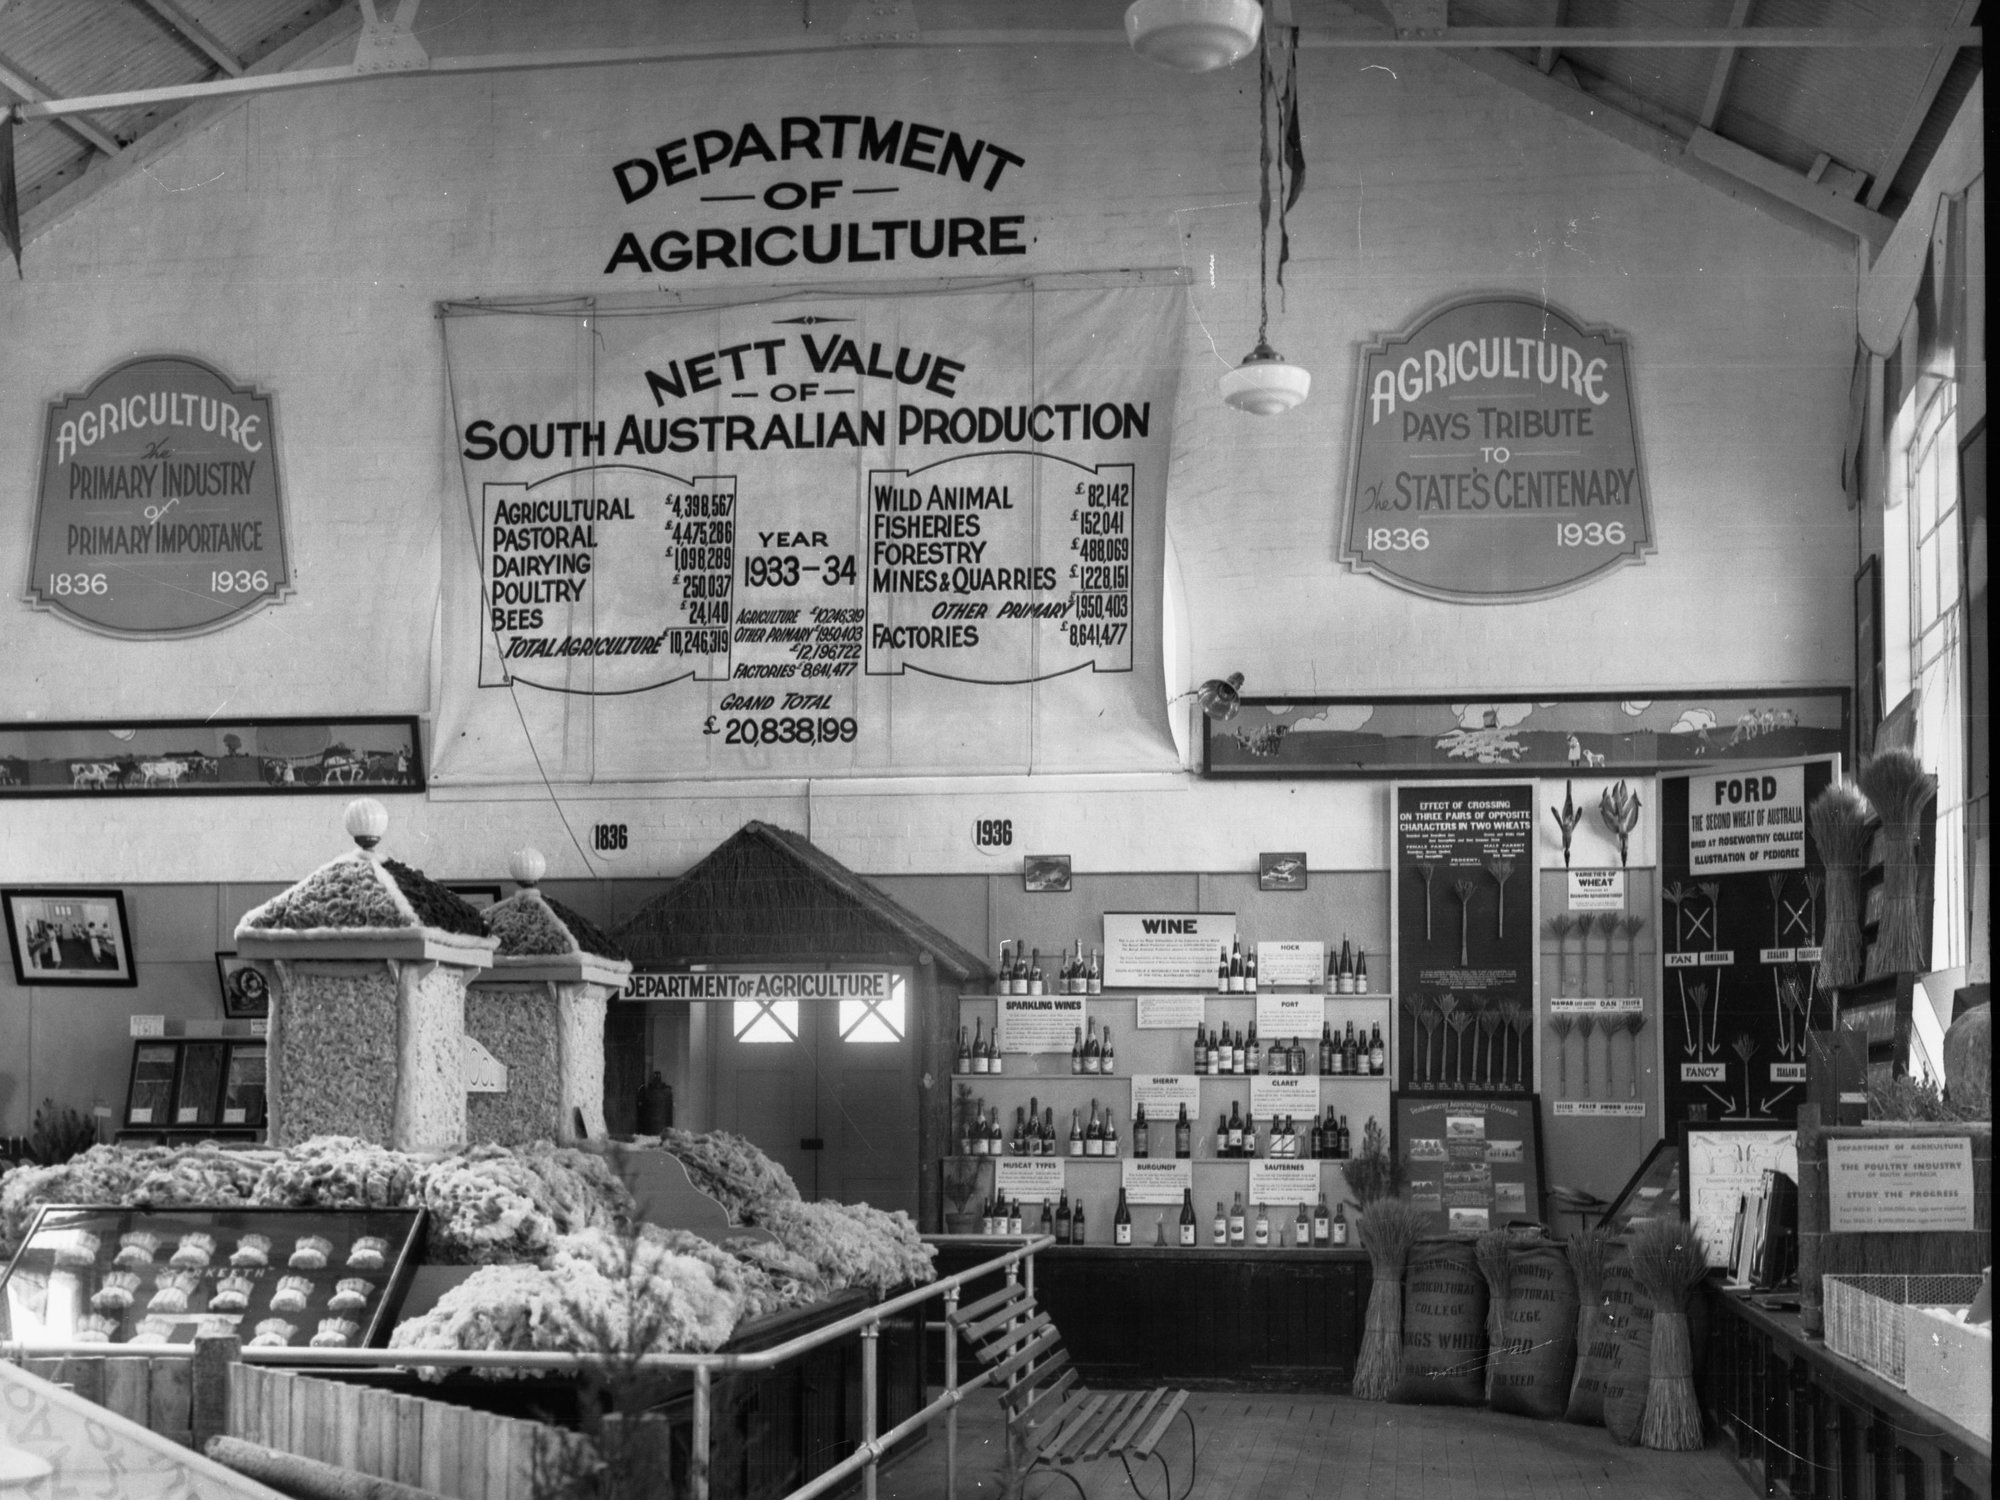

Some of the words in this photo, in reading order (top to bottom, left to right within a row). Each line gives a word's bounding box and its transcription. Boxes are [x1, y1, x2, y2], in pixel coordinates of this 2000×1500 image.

[612, 115, 1025, 204] DEPARTMENT
[763, 180, 843, 211] OF
[604, 215, 1027, 274] AGRICULTURE
[644, 338, 786, 408] NETT
[800, 333, 966, 398] VALUE
[1371, 336, 1610, 426] AGRICULTURE
[769, 383, 819, 403] OF
[56, 391, 262, 465] AGRICULTURE
[463, 419, 605, 461] SOUTH
[614, 408, 885, 457] AUSTRALIAN
[898, 401, 1150, 446] PRODUCTION
[1403, 411, 1471, 442] PAYS
[1477, 407, 1593, 439] TRIBUTE
[141, 437, 172, 460] The
[1480, 447, 1510, 463] TO
[70, 461, 158, 499] PRIMARY
[162, 460, 255, 497] INDUSTRY
[1361, 480, 1389, 513] The
[1393, 466, 1490, 511] STATE'S
[1494, 468, 1635, 509] CENTENARY
[494, 498, 635, 525] AGRICULTURAL
[665, 494, 734, 519] £4,398,567
[874, 485, 922, 512] WILD
[927, 484, 1014, 510] ANIMAL
[1075, 482, 1129, 509] £82,142
[144, 498, 179, 524] of
[874, 514, 980, 538] FISHERIES
[1070, 509, 1124, 536] £152,041
[68, 524, 153, 555] PRIMARY
[156, 521, 263, 553] IMPORTANCE
[493, 525, 598, 552] PASTORAL
[665, 520, 732, 546] £4,475,286
[758, 531, 829, 548] YEAR
[1367, 527, 1429, 550] 1836
[1557, 522, 1626, 546] 1936
[493, 553, 591, 579] DAIRYING
[665, 546, 731, 572] £1,098,289
[874, 541, 987, 565] FORESTRY
[1071, 537, 1128, 564] £488,069
[50, 573, 108, 595] 1836
[211, 570, 269, 592] 1936
[744, 554, 857, 587] 1933-34
[492, 579, 586, 606] POULTRY
[672, 574, 731, 600] £250,037
[491, 608, 544, 632] BEES
[680, 600, 729, 626] £24,140
[735, 608, 801, 624] AGRICULTURE
[932, 601, 988, 620] OTHER
[996, 601, 1075, 619] PRIMARY
[1069, 592, 1127, 620] £1,950,403
[504, 636, 556, 659] TOTAL
[554, 635, 663, 658] AGRICULTURE
[663, 629, 729, 656] £10,246,319
[734, 626, 766, 643] OTHER
[766, 626, 814, 642] PRIMARY
[872, 623, 979, 649] FACTORIES
[1060, 620, 1128, 648] £8,641,477
[733, 663, 796, 679] FACTORIES
[795, 661, 858, 679] £8,641,477
[719, 694, 774, 711] GRAND
[780, 693, 833, 711] TOTAL
[1715, 776, 1777, 805] FORD
[1399, 813, 1412, 821] ON
[1415, 813, 1443, 821] THREE
[1445, 812, 1472, 820] PAIRS
[1474, 812, 1485, 820] OF
[1488, 811, 1530, 820] OPPOSITE
[1419, 802, 1450, 811] EFFECT
[1452, 802, 1463, 810] OF
[1467, 800, 1511, 809] CROSSING
[1399, 822, 1457, 832] CHARACTERS
[1458, 822, 1468, 831] IN
[1470, 822, 1491, 831] TWO
[1493, 821, 1531, 831] WHEATS
[1692, 814, 1704, 832] THE
[1706, 811, 1731, 831] SECOND
[1733, 810, 1755, 829] WHEAT
[1757, 809, 1765, 826] OF
[1767, 806, 1803, 824] AUSTRALIA
[594, 825, 627, 850] 1836
[976, 820, 1012, 846] 1936
[1691, 840, 1706, 849] BRED
[1708, 839, 1716, 848] AT
[1718, 833, 1770, 846] ROSEWORTHY
[1773, 831, 1803, 842] COLLEGE
[1695, 852, 1745, 865] ILLUSTRATION
[1749, 851, 1759, 861] OF
[1763, 848, 1799, 860] PEDIGREE
[1578, 878, 1614, 887] WHEAT
[1141, 919, 1198, 935] WINE
[1671, 955, 1691, 964] FAN
[625, 974, 738, 998] DEPARTMENT
[738, 980, 755, 996] OF
[755, 975, 884, 997] AGRICULTURE
[1006, 1000, 1052, 1010] SPARKLING
[1054, 1000, 1081, 1010] WINES
[1686, 1068, 1719, 1077] FANCY
[1777, 1067, 1798, 1078] ZEALAND
[1837, 1144, 1889, 1152] DEPARTMENT
[1840, 1163, 1859, 1171] THE
[1864, 1162, 1908, 1170] POULTRY
[1914, 1161, 1962, 1170] INDUSTRY
[1847, 1191, 1878, 1199] STUDY
[1909, 1190, 1959, 1198] PROGRESS
[1415, 1303, 1465, 1316] COLLEGE
